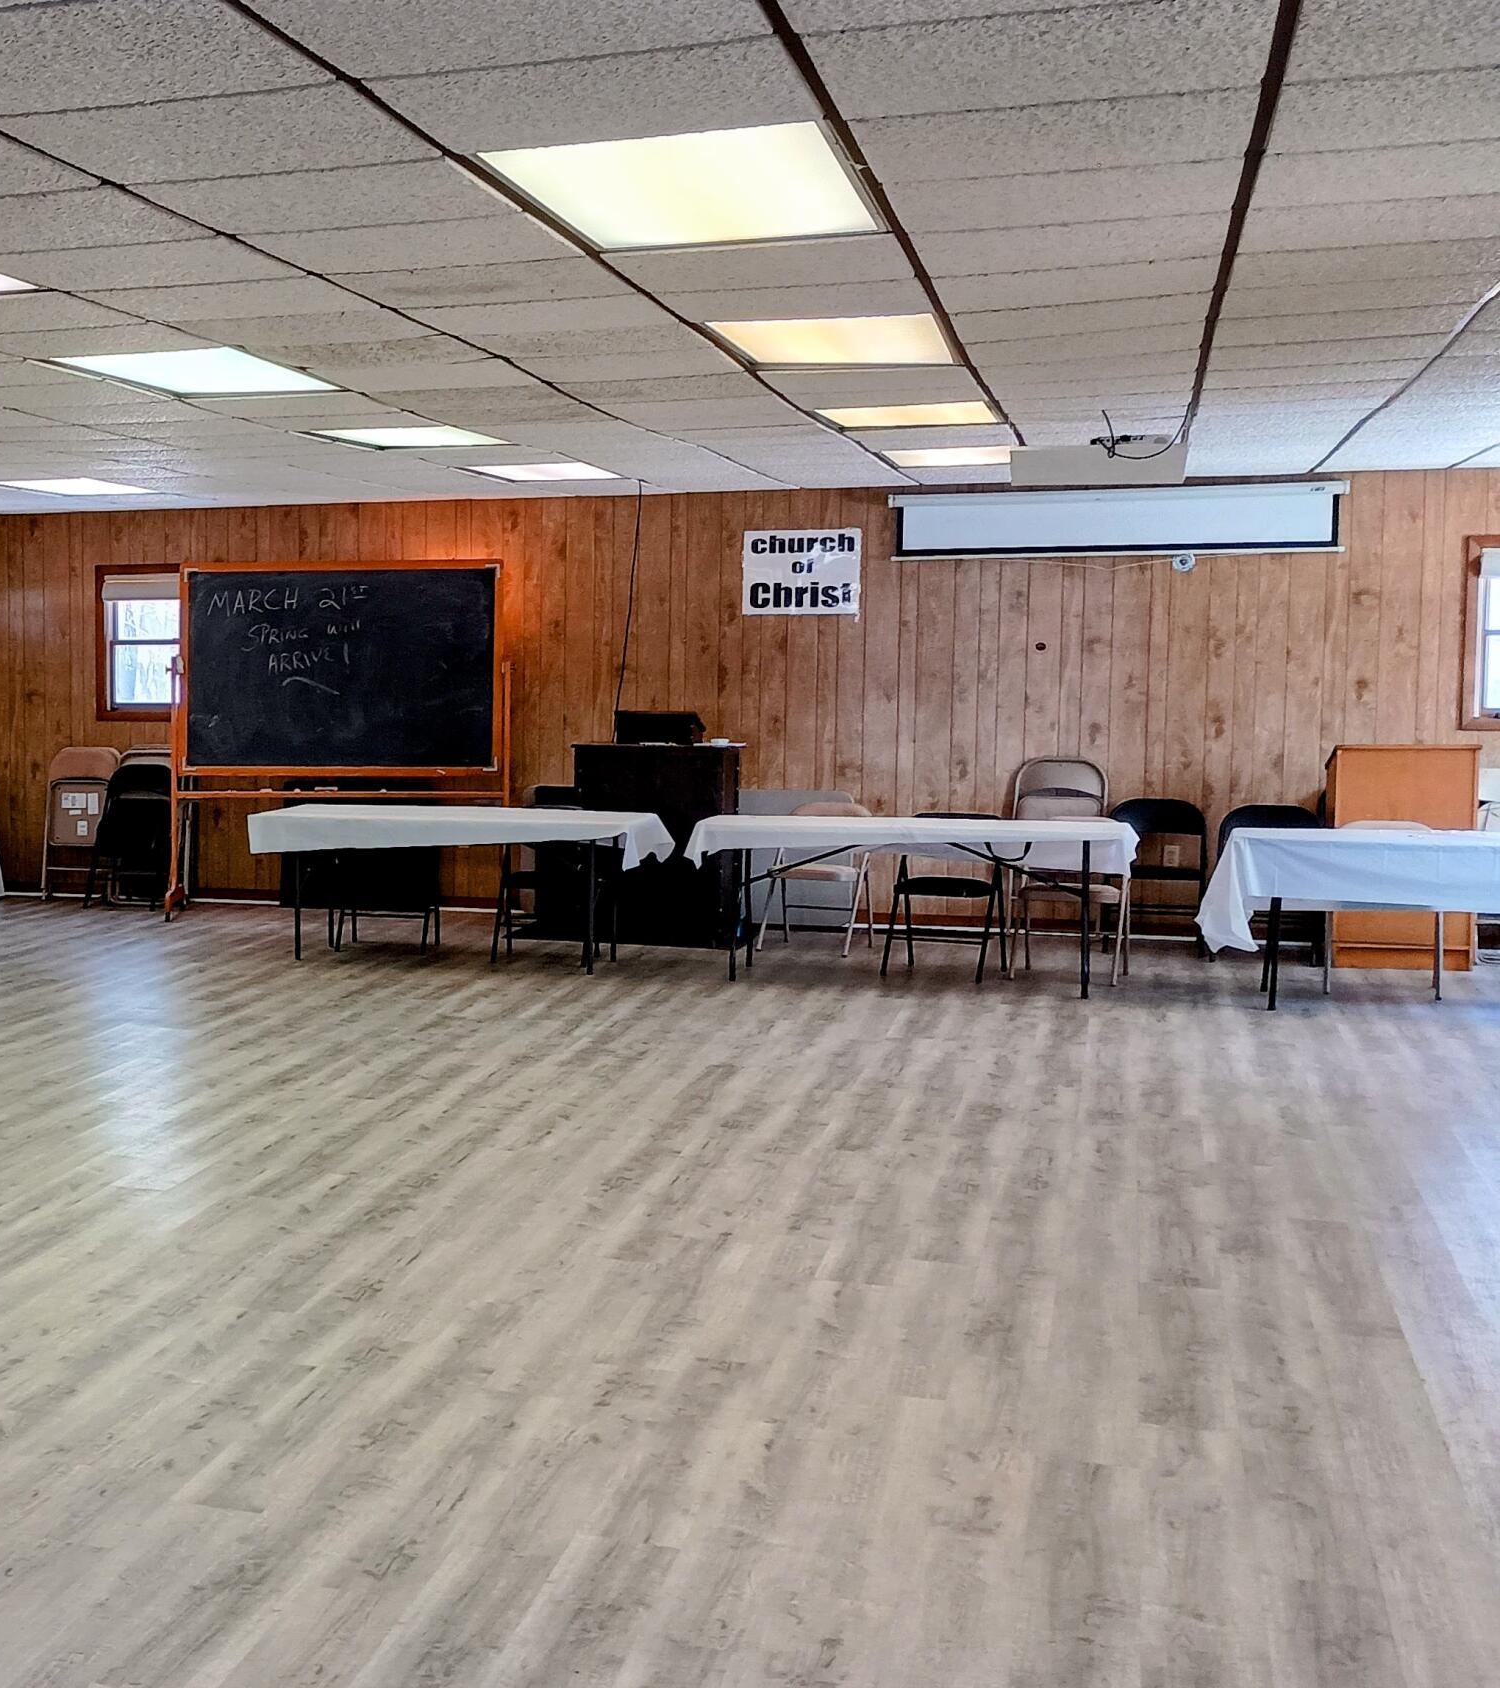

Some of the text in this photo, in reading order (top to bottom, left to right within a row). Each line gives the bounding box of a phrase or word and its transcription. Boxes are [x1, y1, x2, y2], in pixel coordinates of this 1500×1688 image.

[750, 534, 855, 554] church
[791, 558, 814, 573] of
[207, 587, 299, 617] MARCH
[750, 582, 851, 609] Christ
[241, 623, 309, 652] SPRING
